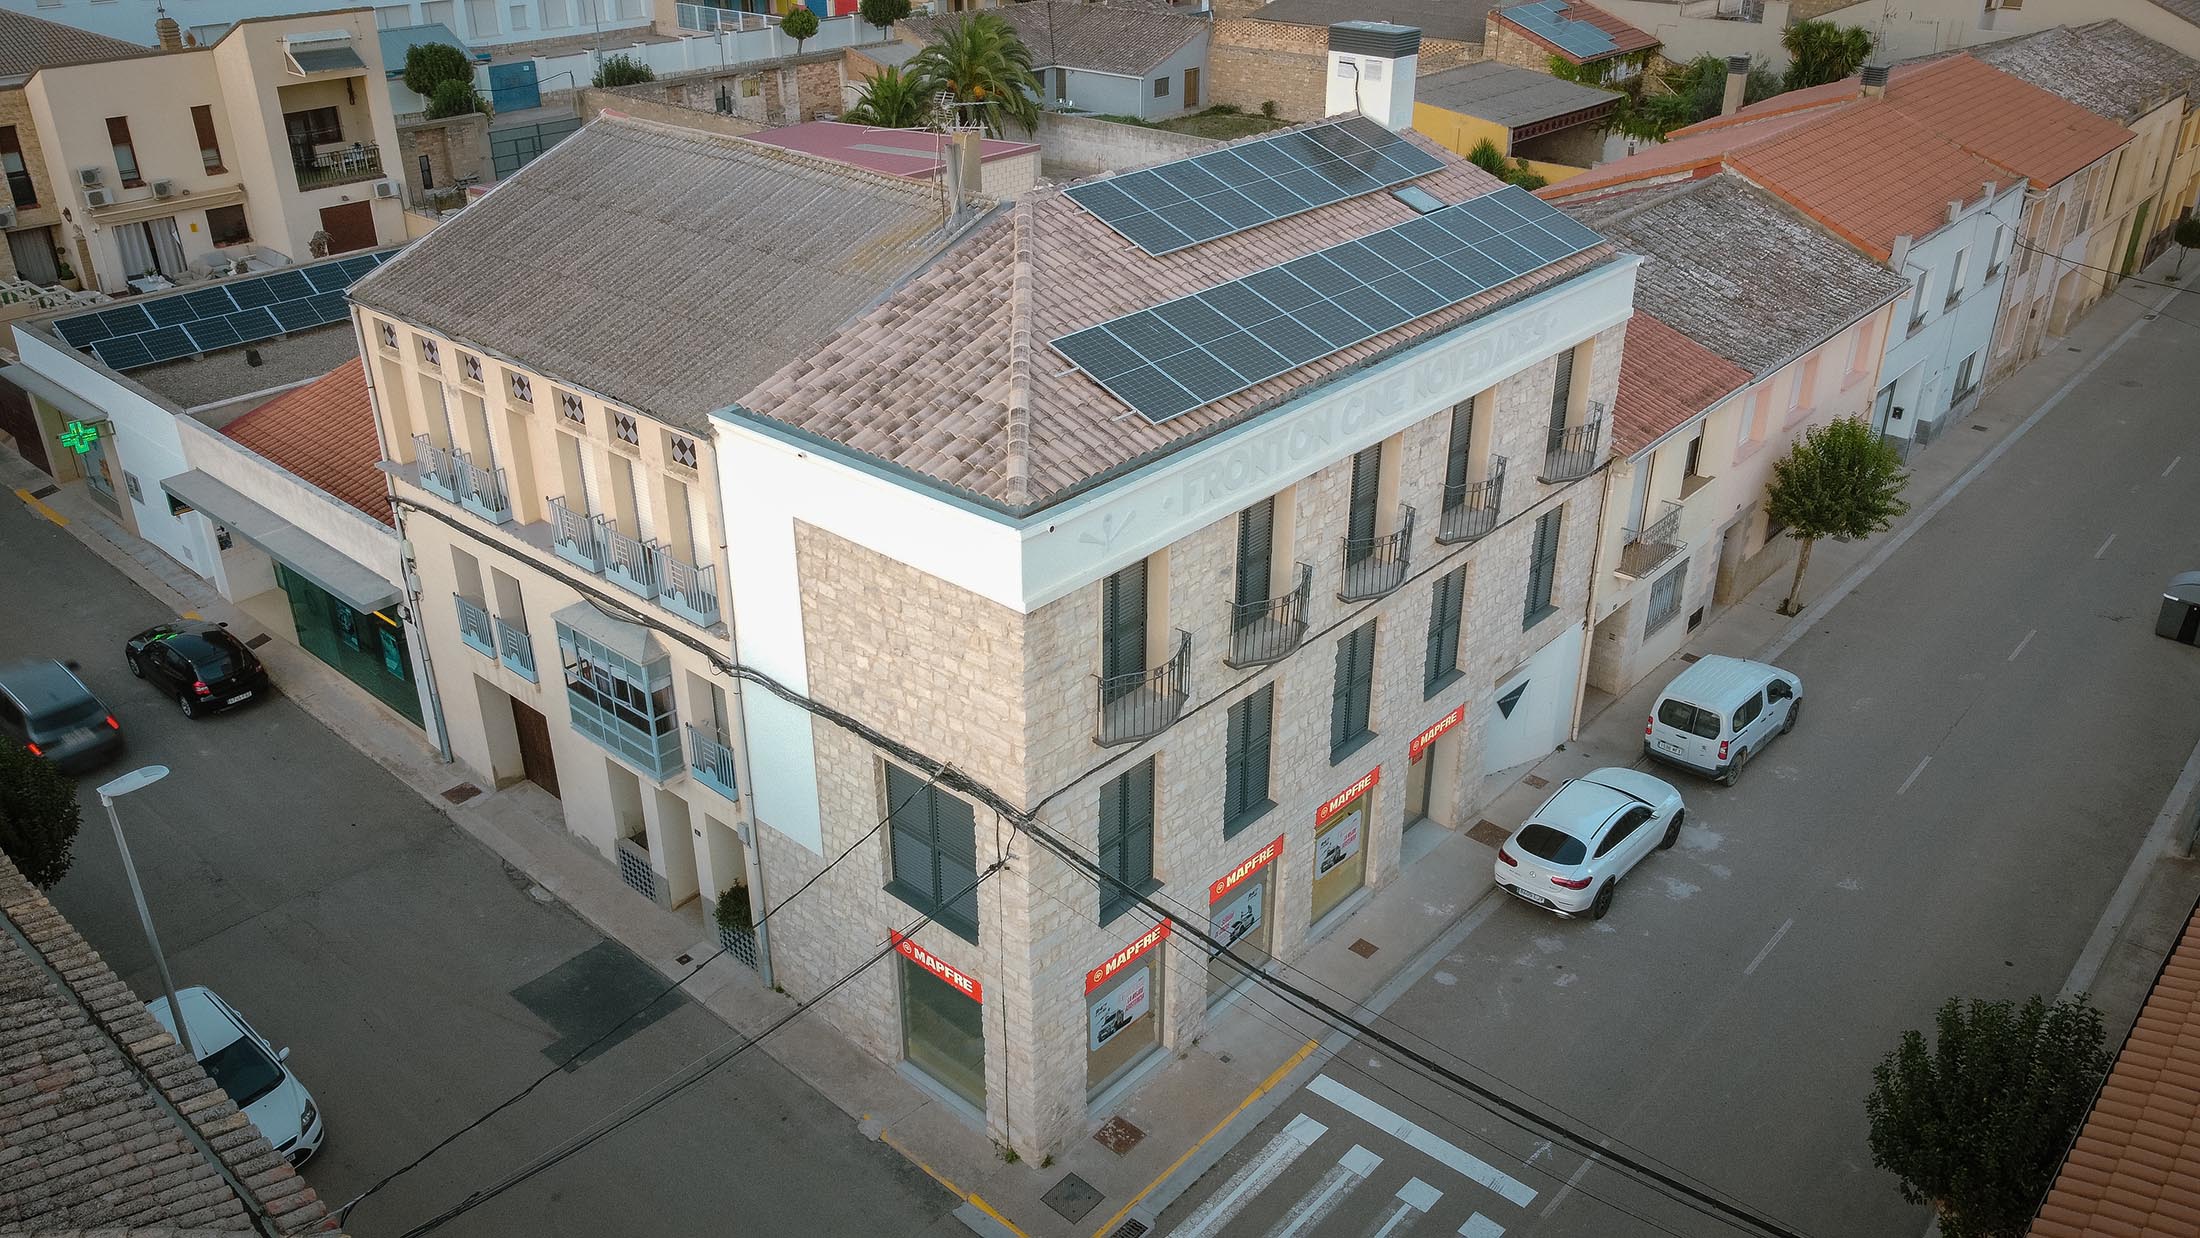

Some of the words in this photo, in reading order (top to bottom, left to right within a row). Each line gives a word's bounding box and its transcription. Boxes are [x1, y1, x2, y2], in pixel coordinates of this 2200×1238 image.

[1180, 408, 1331, 514] FRONTON
[1341, 374, 1405, 436] CINE
[1412, 311, 1546, 406] NOVEDADES
[1420, 711, 1457, 746] MAPFRE
[1329, 775, 1371, 812] MAPFRE
[1226, 845, 1274, 887] MAPFRE
[914, 947, 973, 993] MAPFRE
[1105, 927, 1161, 975] MAPFRE
